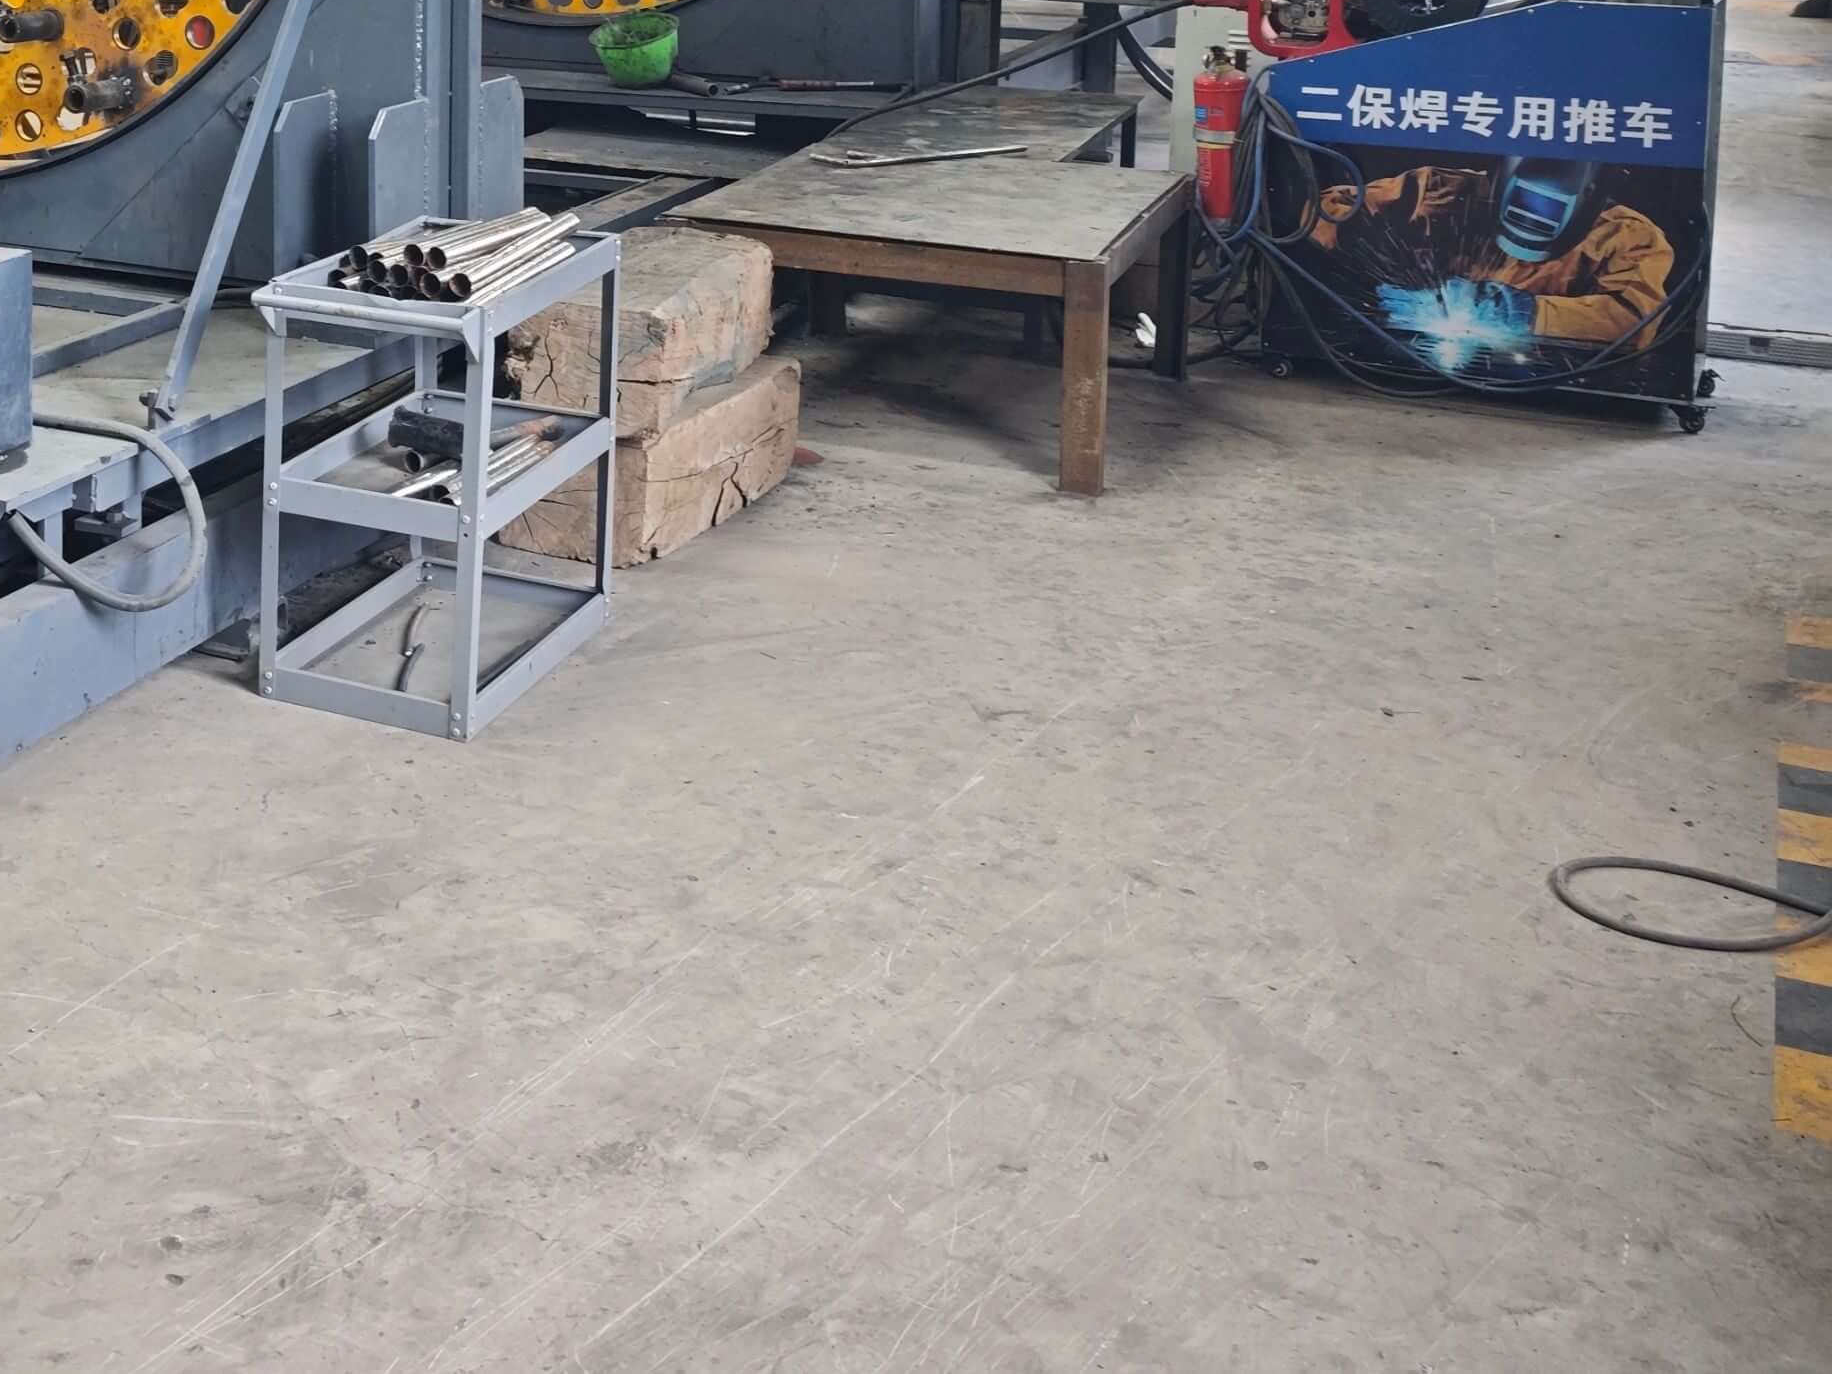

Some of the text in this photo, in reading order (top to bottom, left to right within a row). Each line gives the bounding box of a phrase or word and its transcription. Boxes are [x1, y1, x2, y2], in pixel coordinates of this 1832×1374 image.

[1296, 83, 1673, 149] 二保焊专用推车
